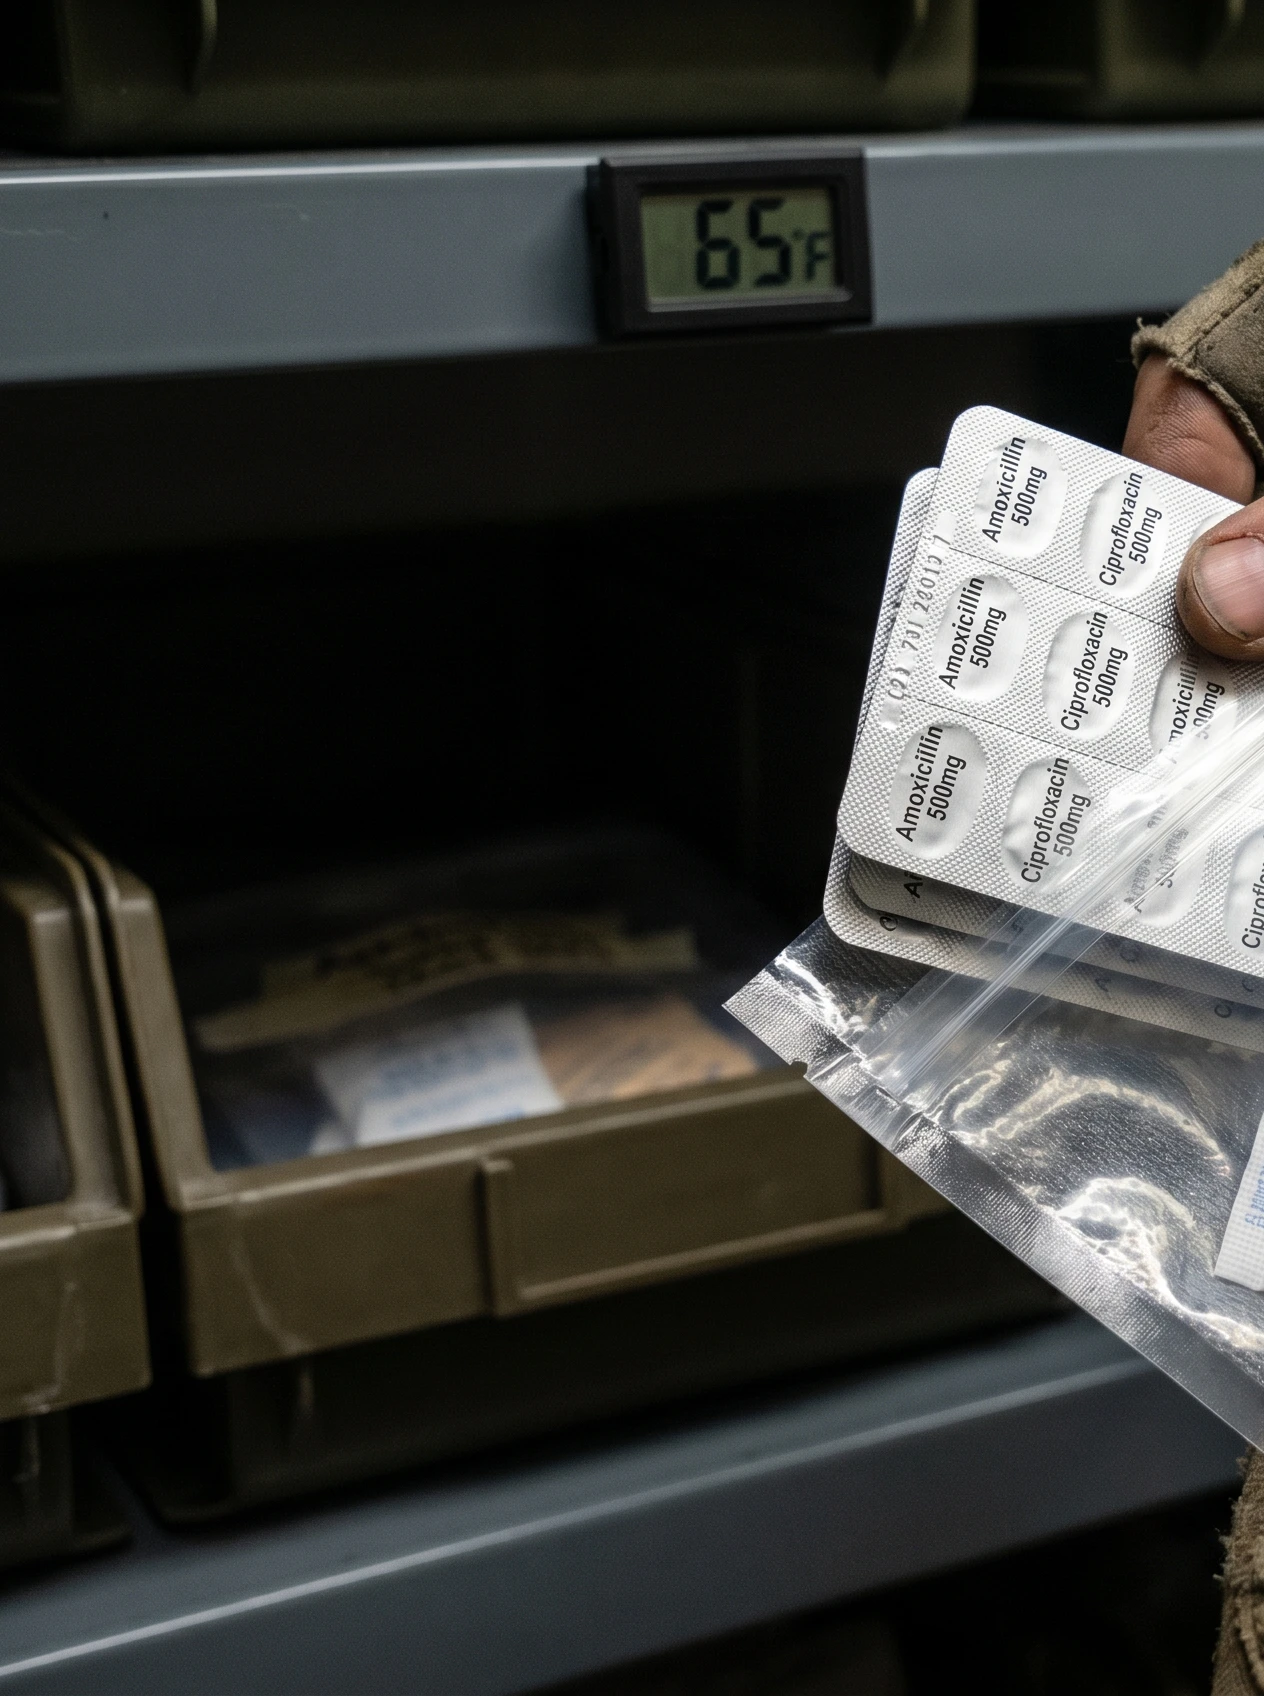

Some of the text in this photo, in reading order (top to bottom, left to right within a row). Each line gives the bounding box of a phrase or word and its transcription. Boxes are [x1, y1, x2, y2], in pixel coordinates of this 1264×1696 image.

[981, 437, 1026, 542] Amoxicillin
[1011, 466, 1047, 527] 500mg
[1099, 472, 1143, 587] Ciprofloxacin
[1129, 507, 1163, 565] 500mg
[938, 577, 985, 690] Amoxicillin
[971, 608, 1007, 669] 500mg
[1060, 611, 1108, 732] Ciprofloxacin
[1093, 647, 1129, 709] 500mg
[928, 754, 967, 821] 500mg
[1021, 757, 1069, 883] Ciprofloxacin
[1054, 793, 1091, 857] 500mg
